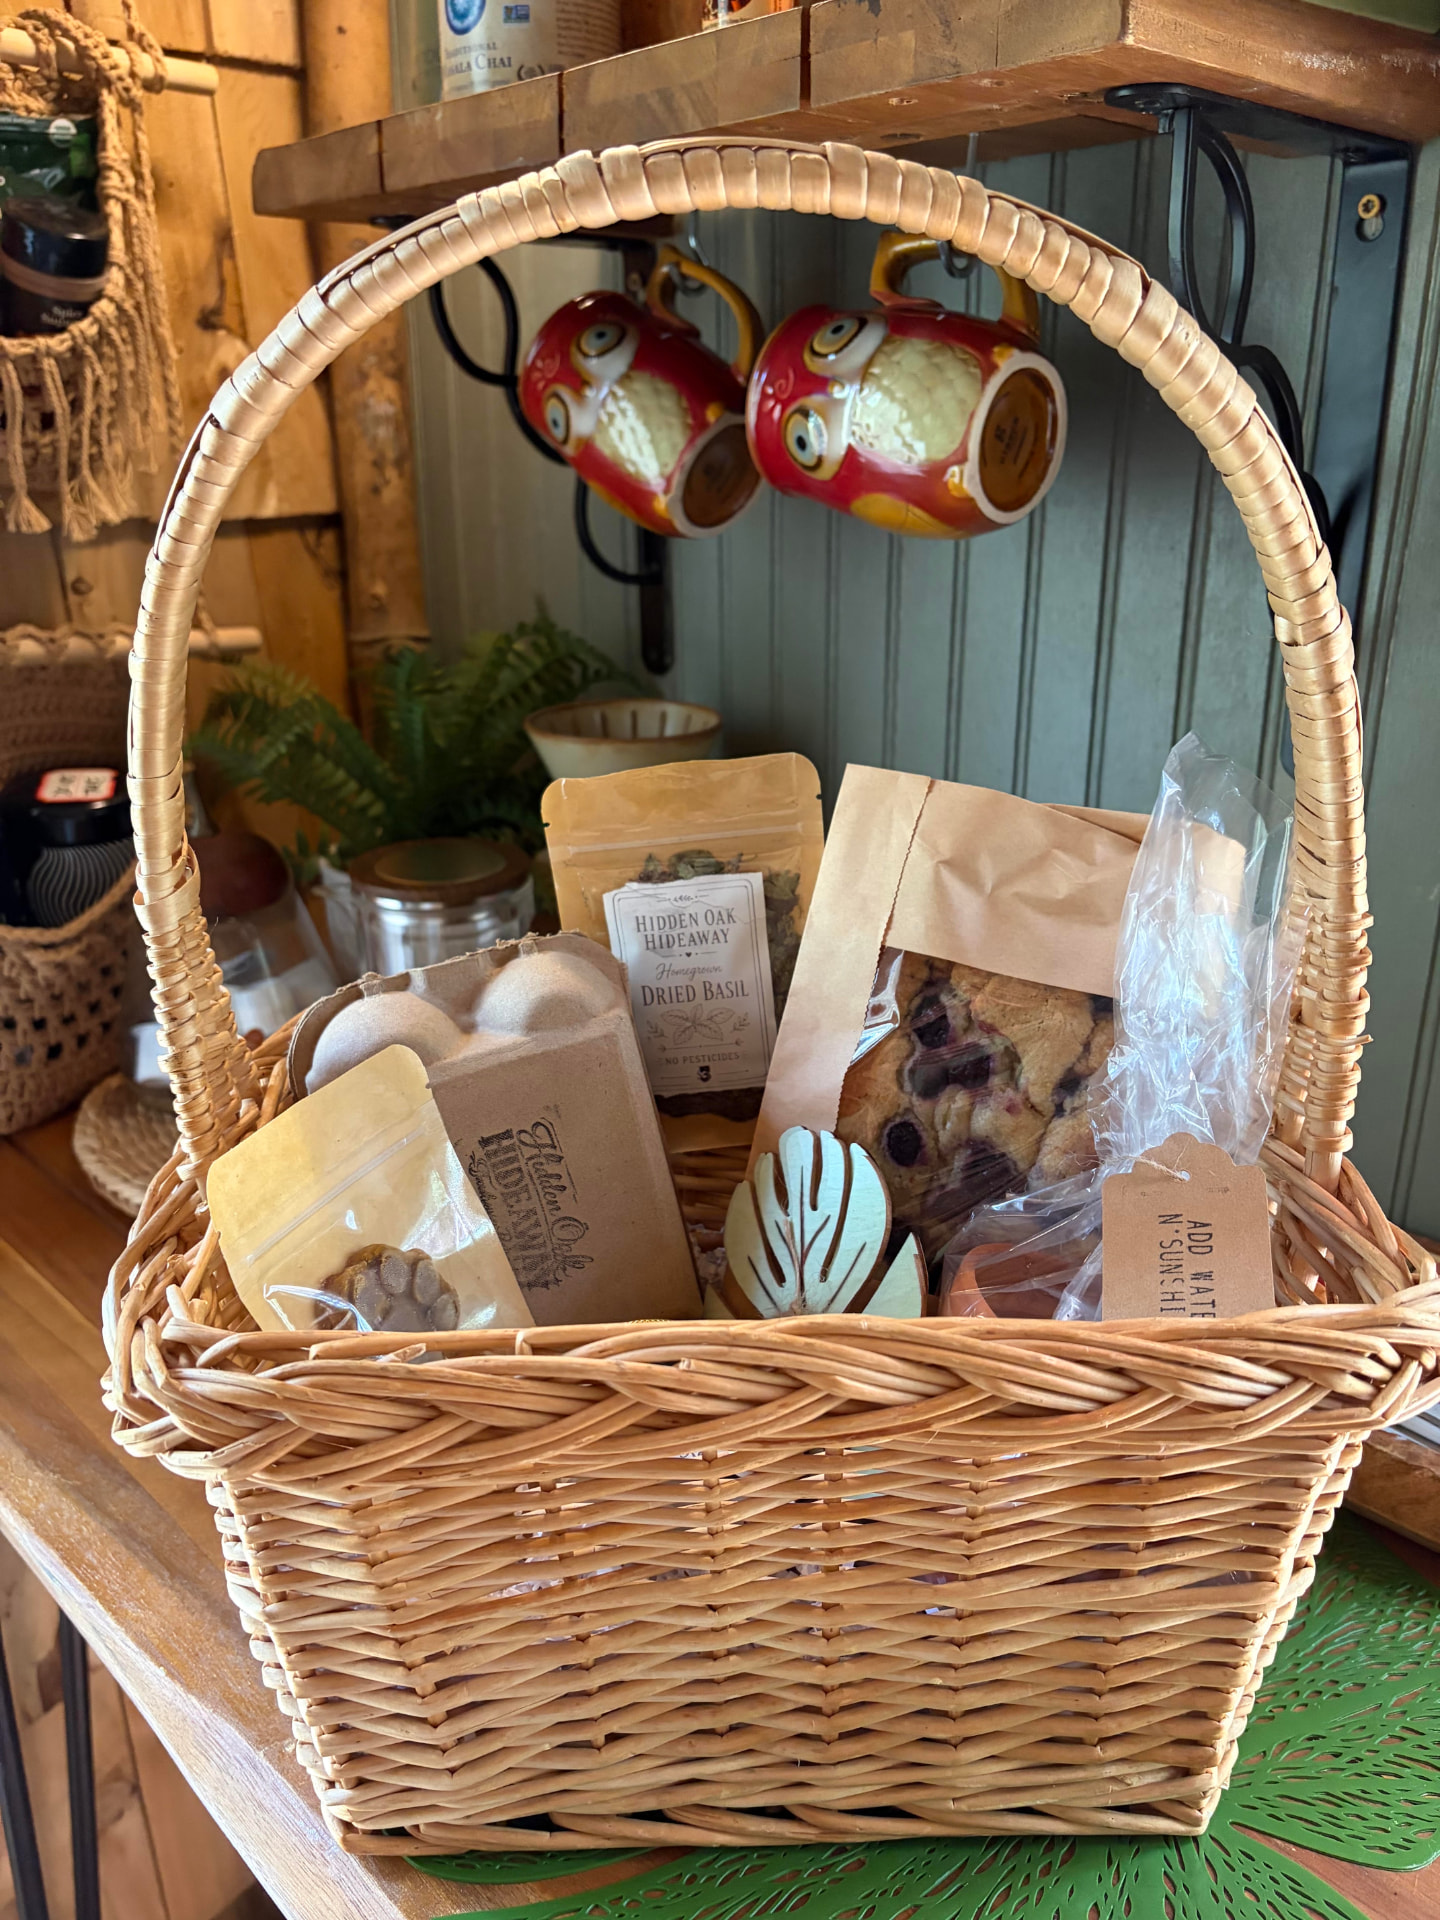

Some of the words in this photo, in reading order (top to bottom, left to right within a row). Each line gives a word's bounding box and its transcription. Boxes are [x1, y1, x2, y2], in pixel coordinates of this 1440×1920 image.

[475, 53, 512, 70] CHAI
[635, 912, 699, 933] HIDDEN
[704, 907, 737, 926] OAK
[644, 928, 730, 950] HIDEAWAY
[655, 963, 723, 981] Homegrown
[641, 984, 697, 1006] DRIED
[703, 980, 750, 1001] BASIL
[665, 1056, 679, 1065] NO
[682, 1052, 740, 1064] PESTICIDES
[478, 1128, 554, 1290] HIDEAWAY
[515, 1120, 567, 1217] Hidden
[550, 1215, 594, 1284] Oak
[1187, 1219, 1214, 1256] ADD
